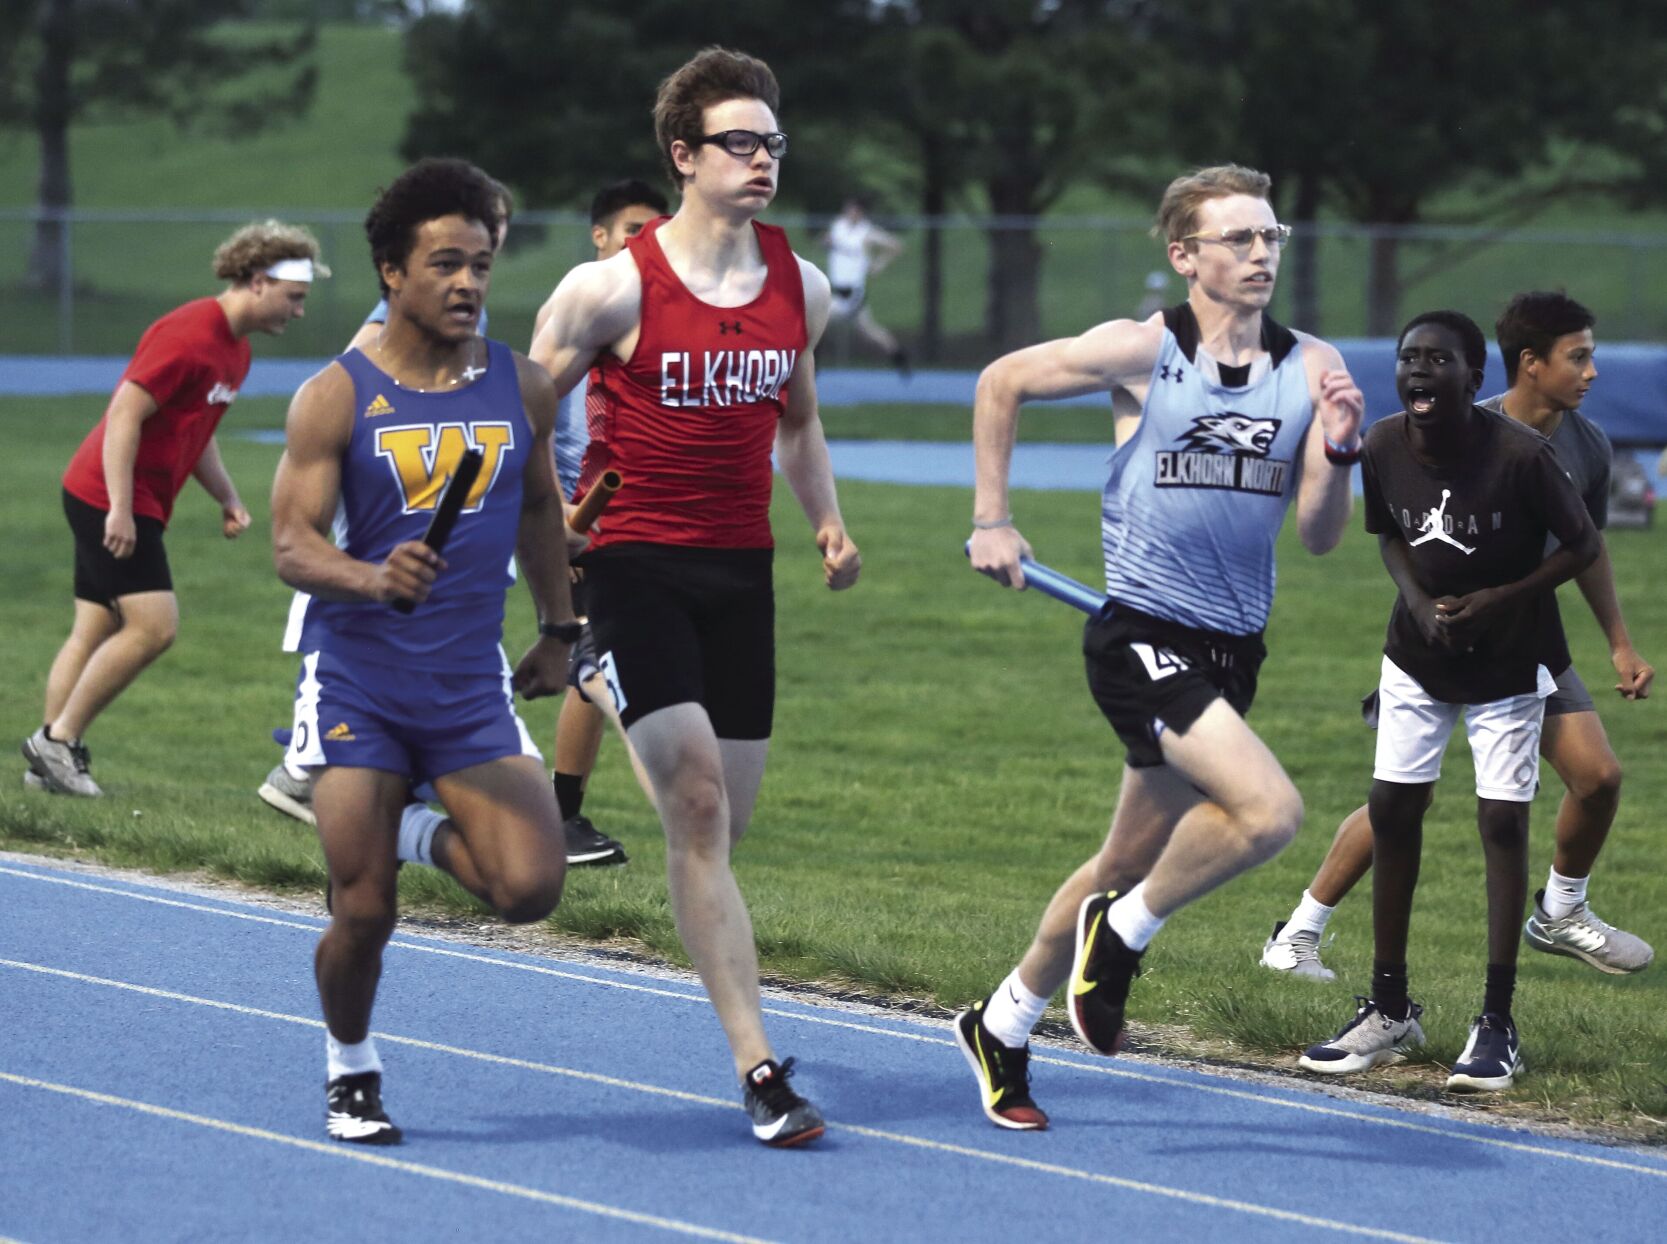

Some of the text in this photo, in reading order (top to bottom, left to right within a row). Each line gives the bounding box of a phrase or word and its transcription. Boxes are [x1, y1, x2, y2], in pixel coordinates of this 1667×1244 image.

[661, 349, 796, 407] ELKHORN
[375, 421, 515, 515] W
[1156, 452, 1237, 488] ELKHORN
[1388, 503, 1502, 535] ODAN
